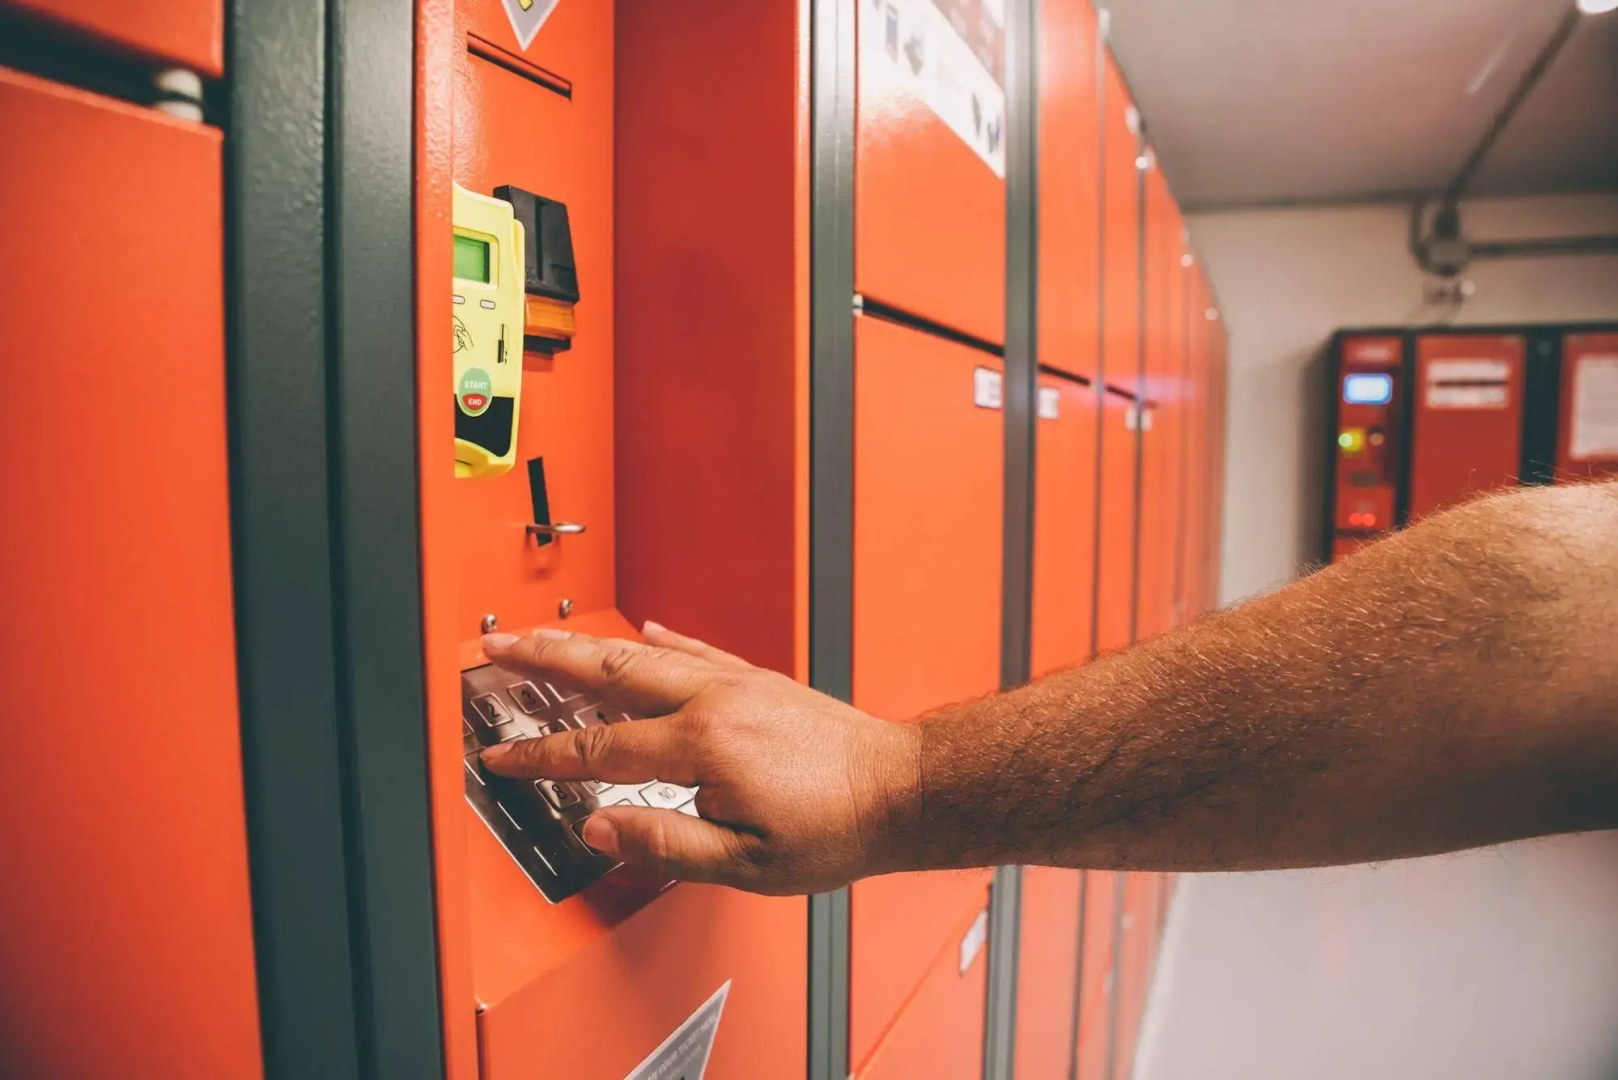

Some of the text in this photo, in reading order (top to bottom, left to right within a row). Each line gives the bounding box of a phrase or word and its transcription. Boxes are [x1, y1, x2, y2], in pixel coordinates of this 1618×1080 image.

[464, 380, 488, 390] START
[468, 398, 482, 406] END
[485, 702, 501, 718] 2
[551, 784, 567, 800] 8
[657, 786, 676, 802] NO
